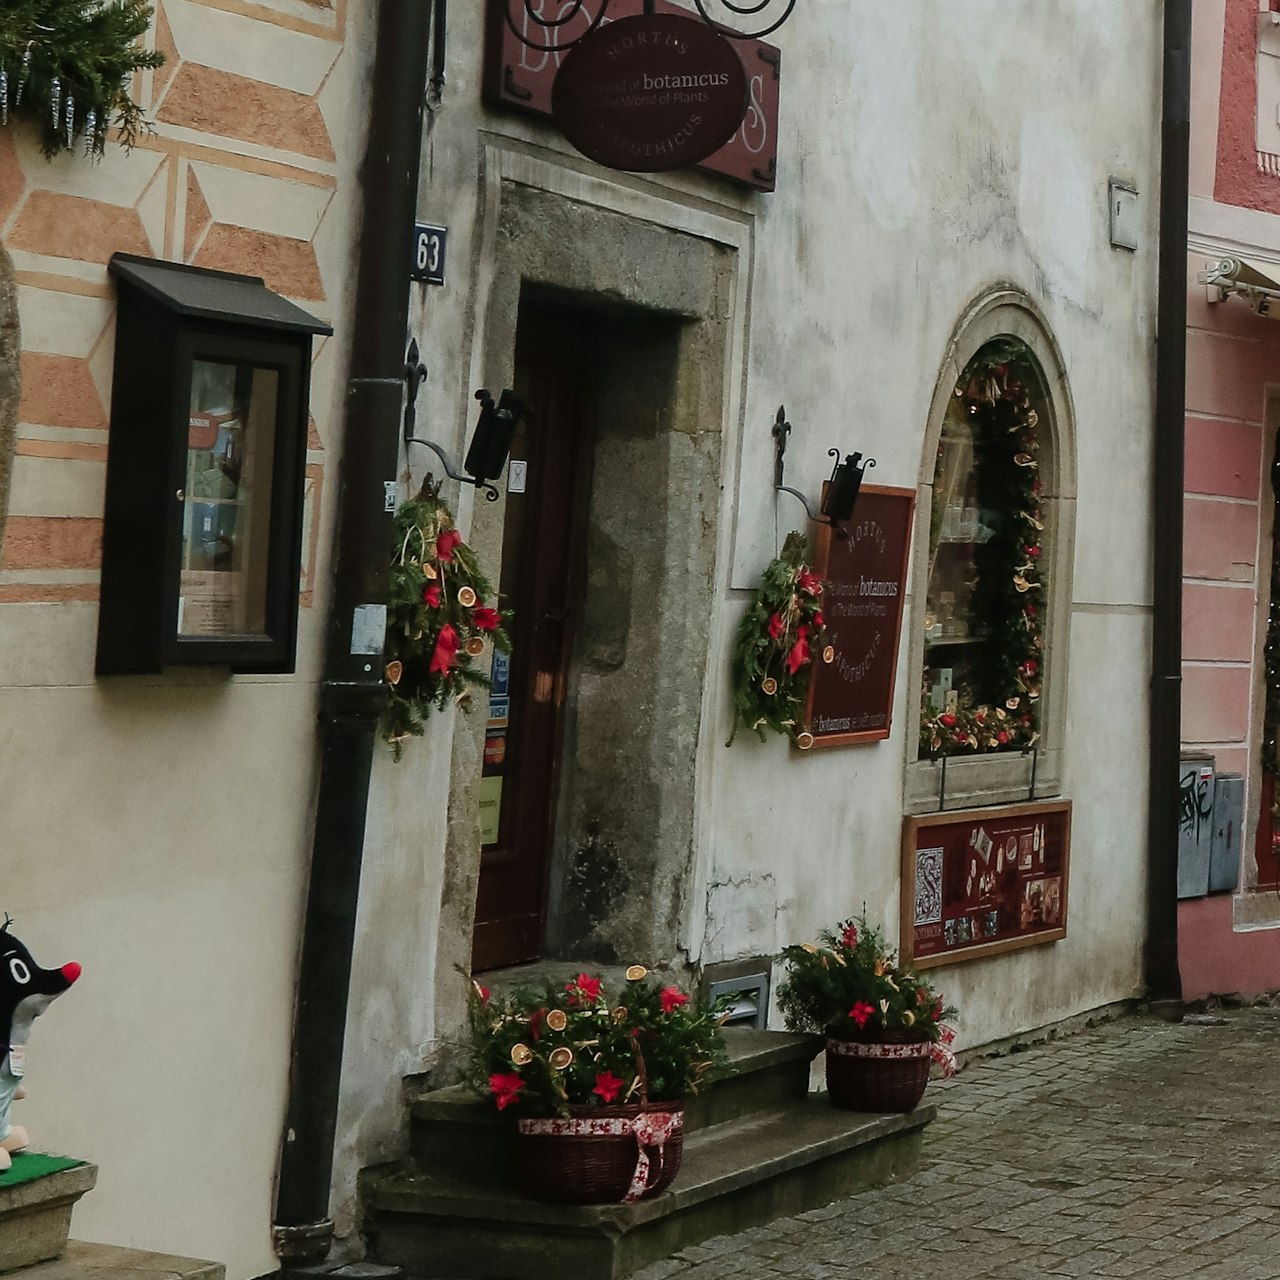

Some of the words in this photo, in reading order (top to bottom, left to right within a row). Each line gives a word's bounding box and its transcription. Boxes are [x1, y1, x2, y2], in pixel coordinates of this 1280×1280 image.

[643, 73, 729, 91] botanicus
[416, 231, 441, 273] 63
[859, 575, 898, 597] botanicus
